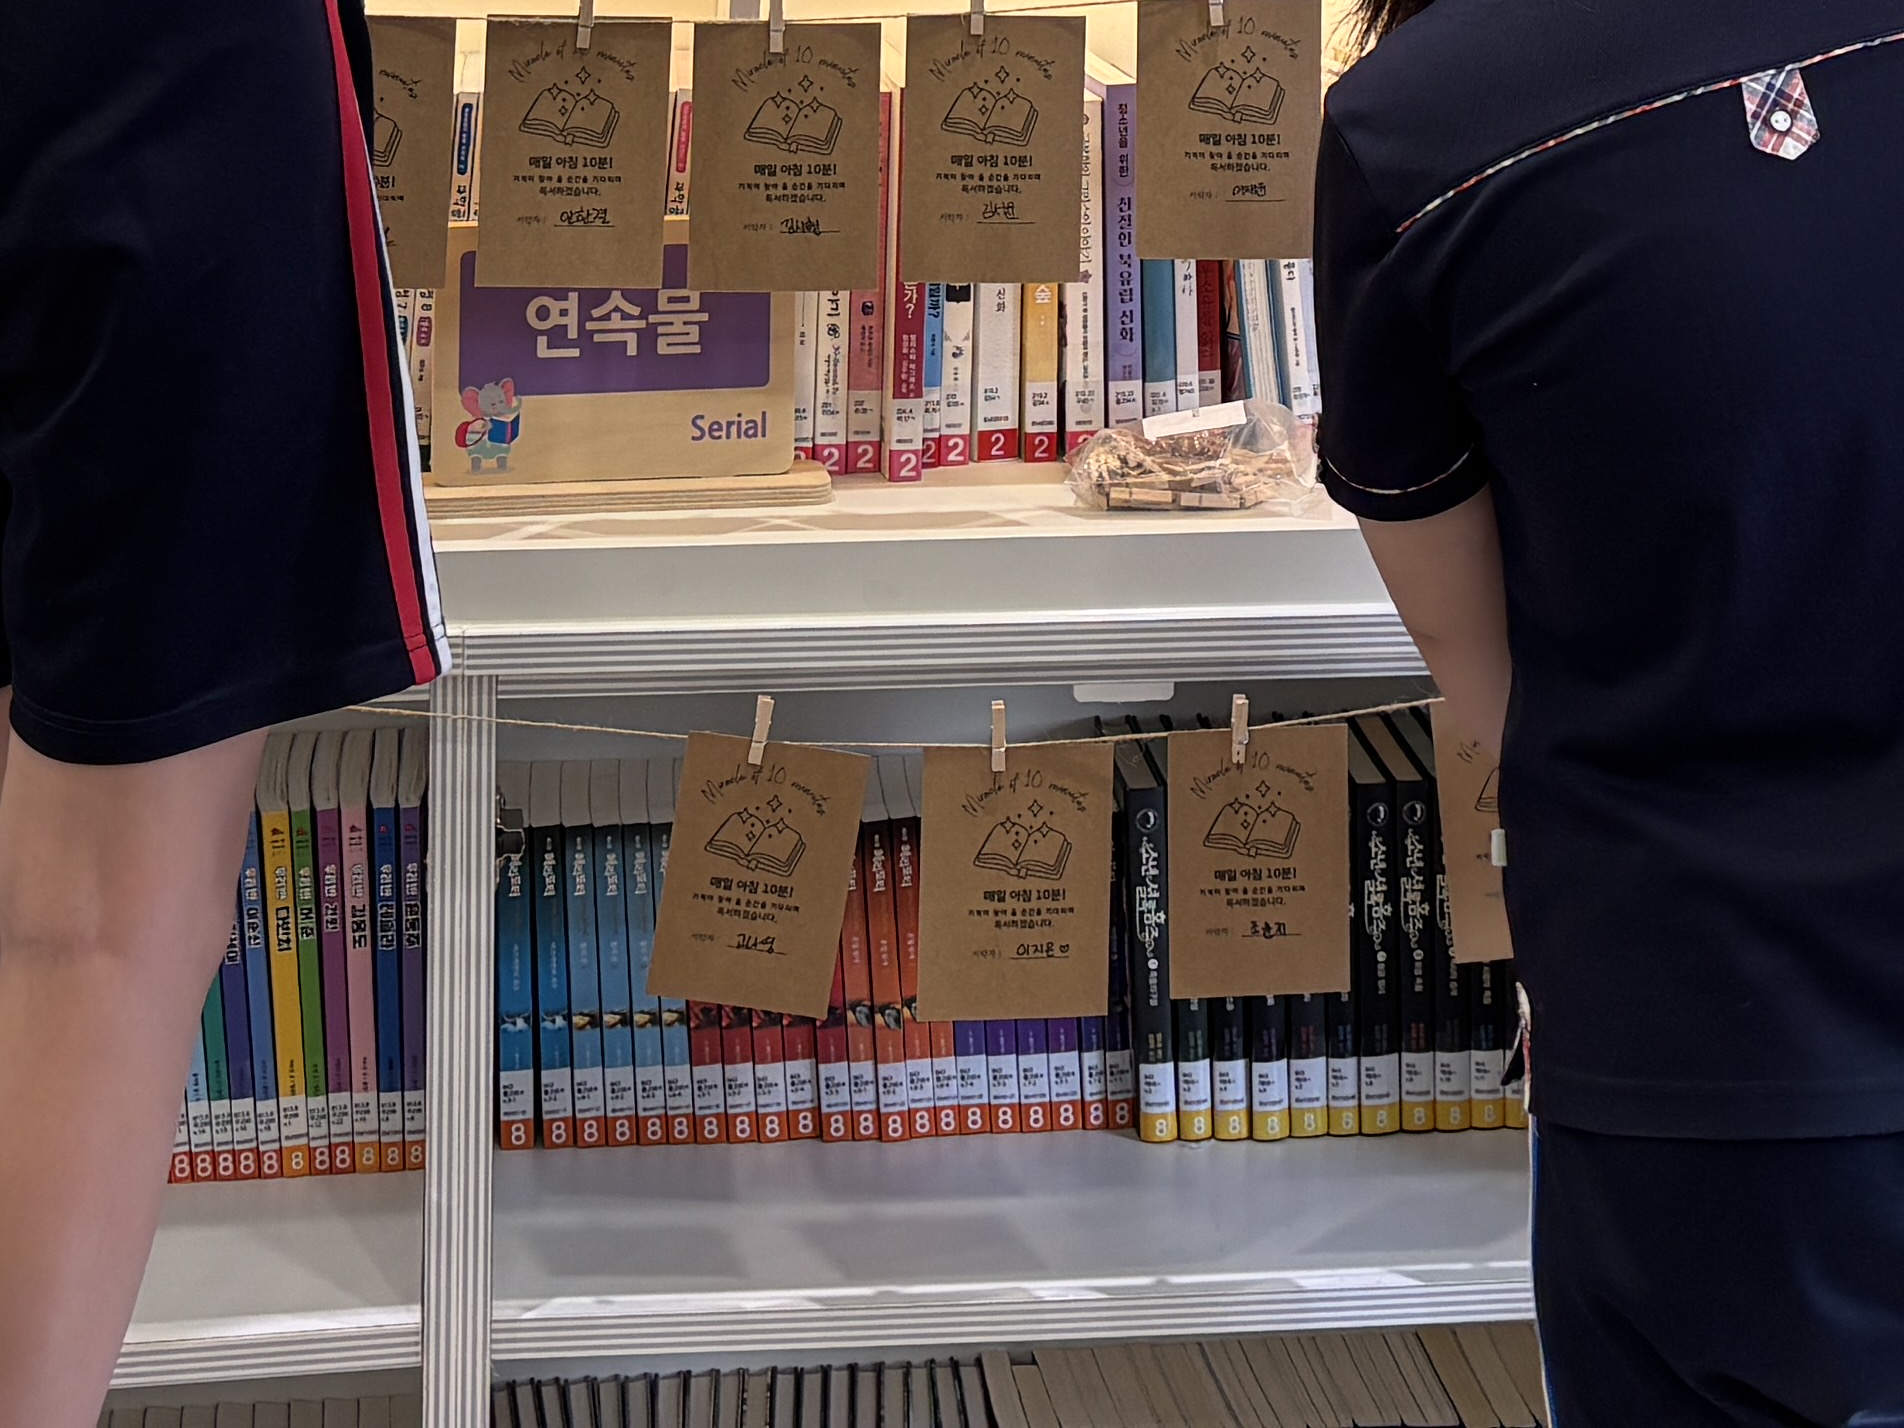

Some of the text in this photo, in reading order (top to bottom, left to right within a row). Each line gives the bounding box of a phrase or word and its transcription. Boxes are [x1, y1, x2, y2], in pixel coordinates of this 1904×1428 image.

[526, 289, 709, 358] 연속물
[691, 411, 767, 441] Serial
[948, 439, 965, 461] 2
[899, 453, 917, 476] 2
[510, 1122, 526, 1145] 8
